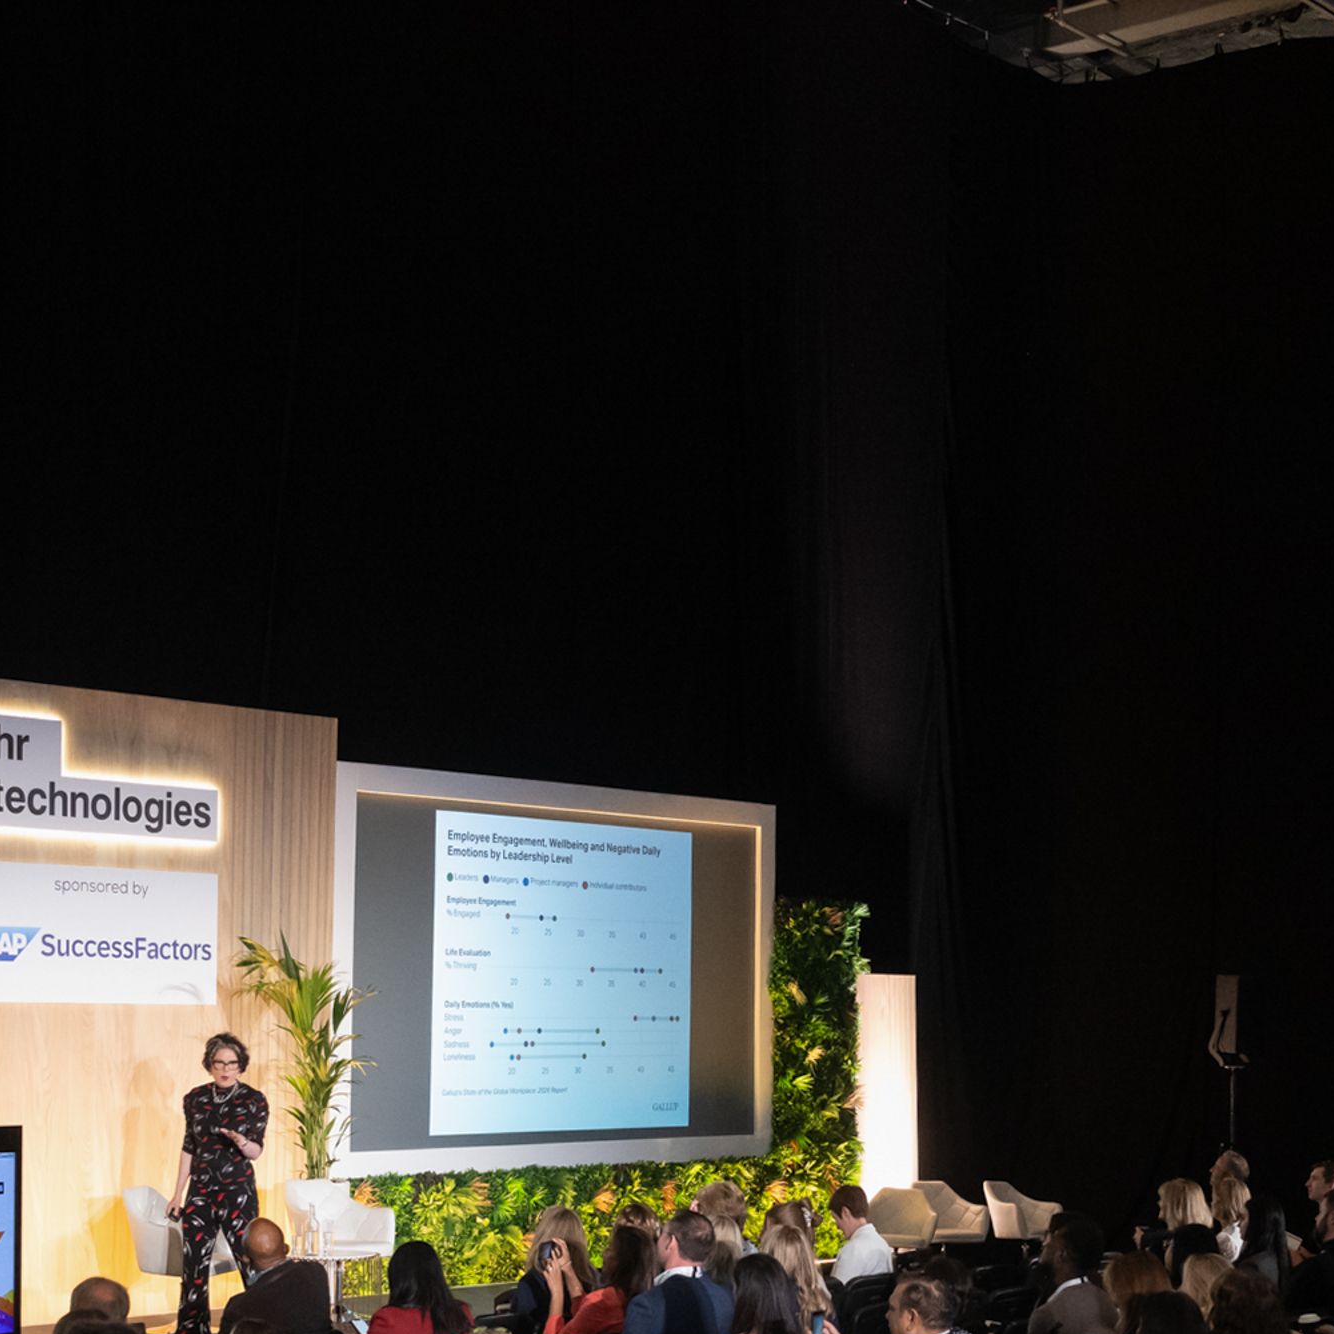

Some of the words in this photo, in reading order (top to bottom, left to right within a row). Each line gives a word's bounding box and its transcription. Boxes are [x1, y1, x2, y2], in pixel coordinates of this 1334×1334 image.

[447, 829, 490, 844] Employee
[549, 838, 588, 853] Wellbeing
[590, 843, 604, 852] and
[607, 843, 640, 855] Negative
[642, 845, 661, 858] Daily
[447, 845, 488, 858] Emotions
[491, 849, 501, 861] by
[503, 850, 549, 864] Leadership
[551, 853, 573, 864] Level
[55, 879, 128, 896] sponsored
[133, 881, 149, 898] by
[41, 934, 211, 960] SuccessFactors
